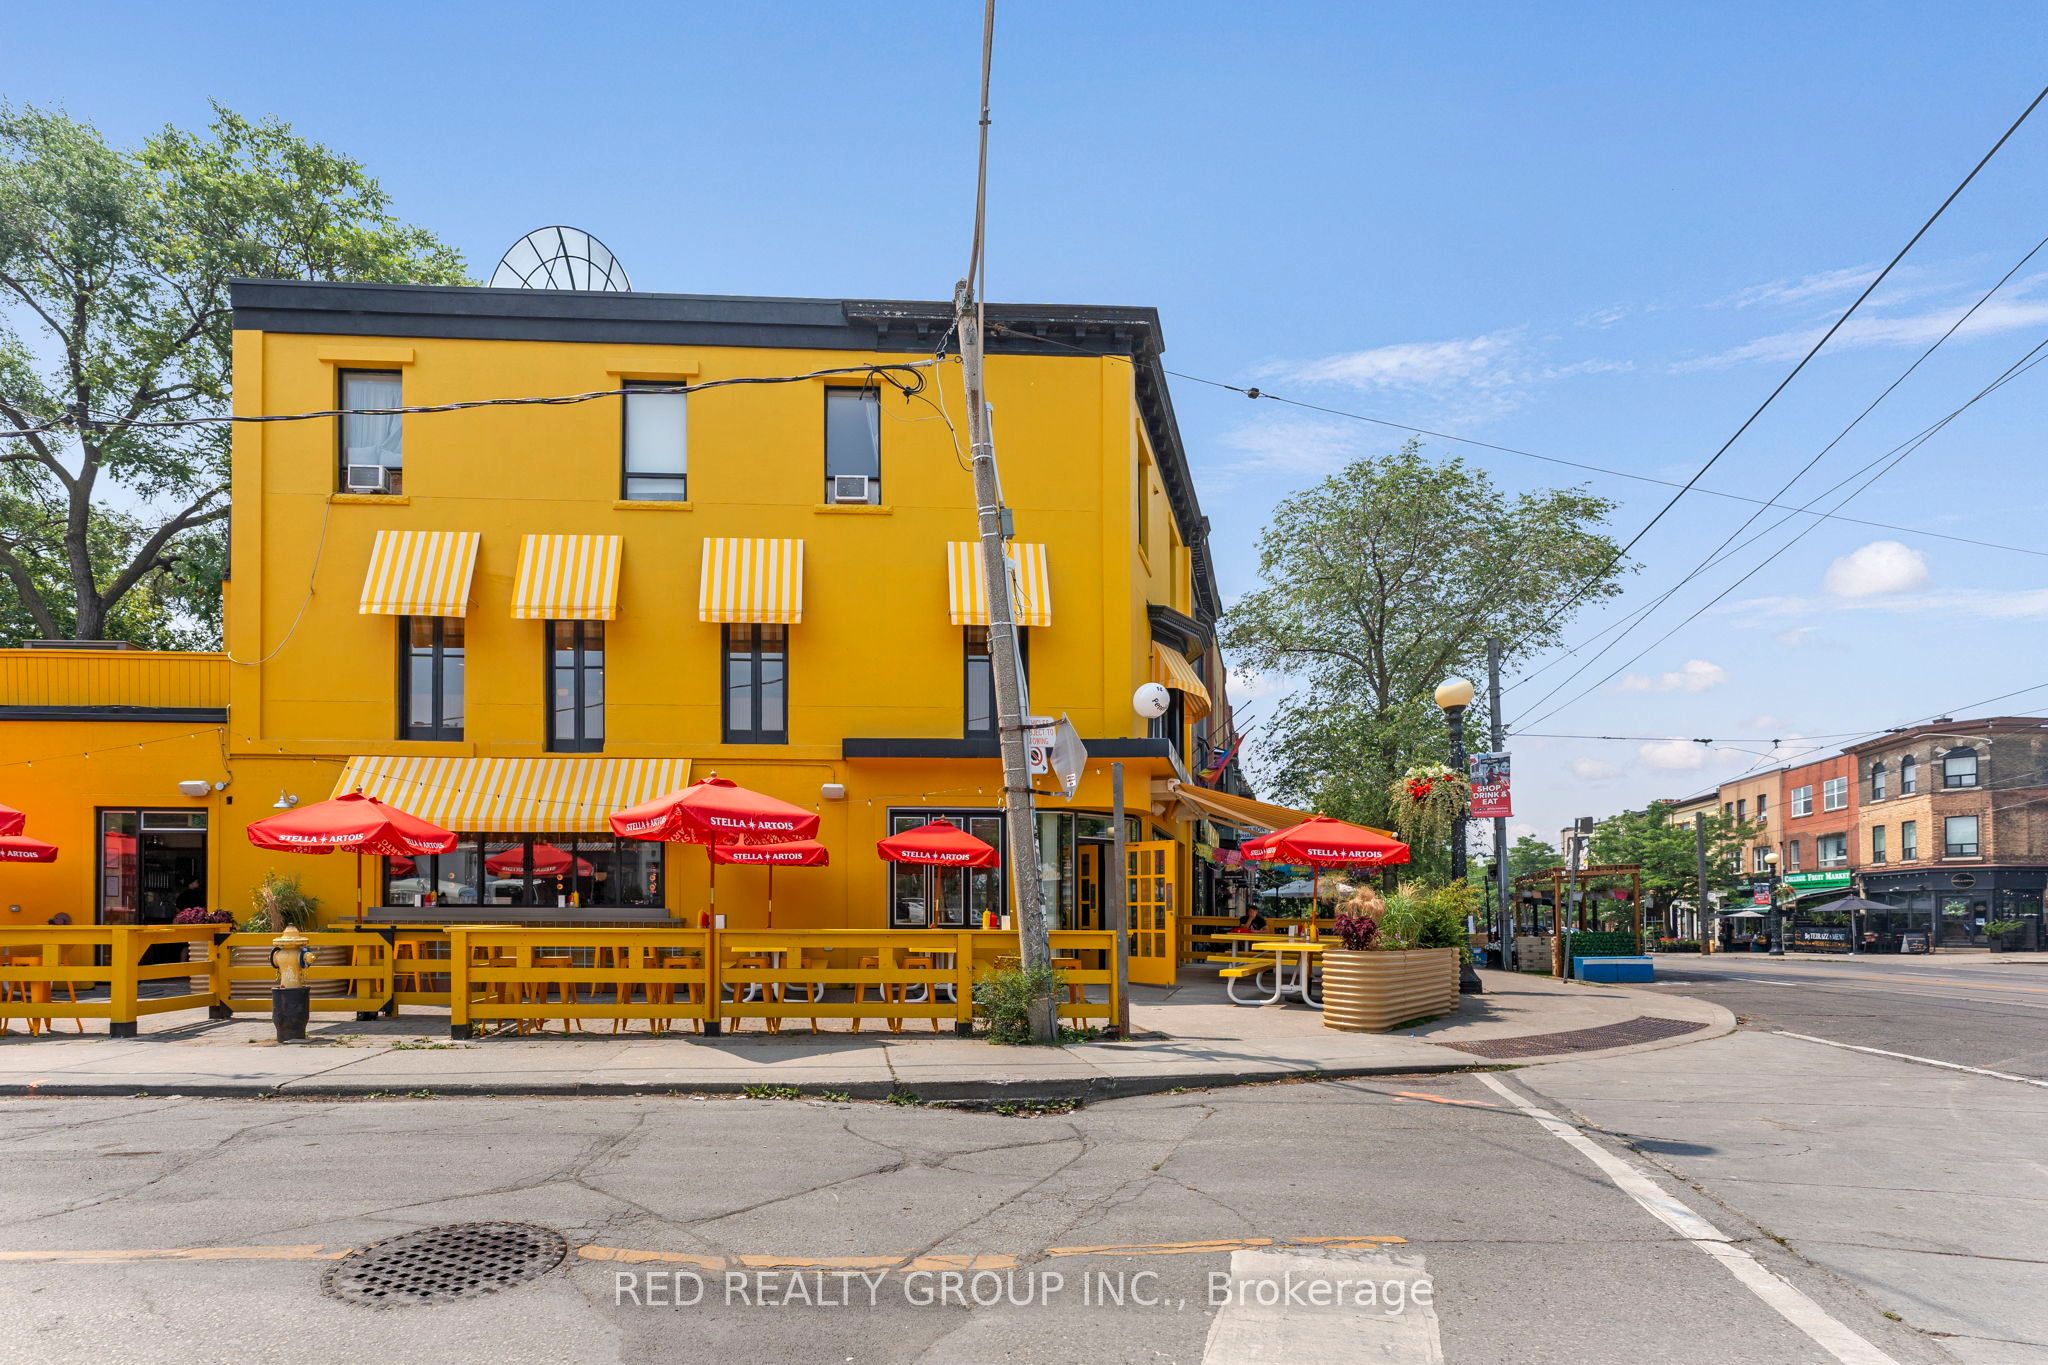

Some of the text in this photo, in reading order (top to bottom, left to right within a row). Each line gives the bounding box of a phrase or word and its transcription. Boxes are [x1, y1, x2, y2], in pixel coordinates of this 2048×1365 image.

[1473, 791, 1500, 799] DRINK
[626, 821, 646, 831] STELLA
[710, 816, 794, 831] STELLA ARTOIS
[278, 833, 364, 843] STELLA ARTOIS
[7, 850, 39, 858] ARTOIS
[733, 852, 803, 860] STELLA ARTOIS
[901, 850, 970, 861] STELLA ARTOIS
[1307, 848, 1338, 857] STELLA
[1808, 873, 1824, 881] FRUIT
[1825, 872, 1850, 880] MARKET
